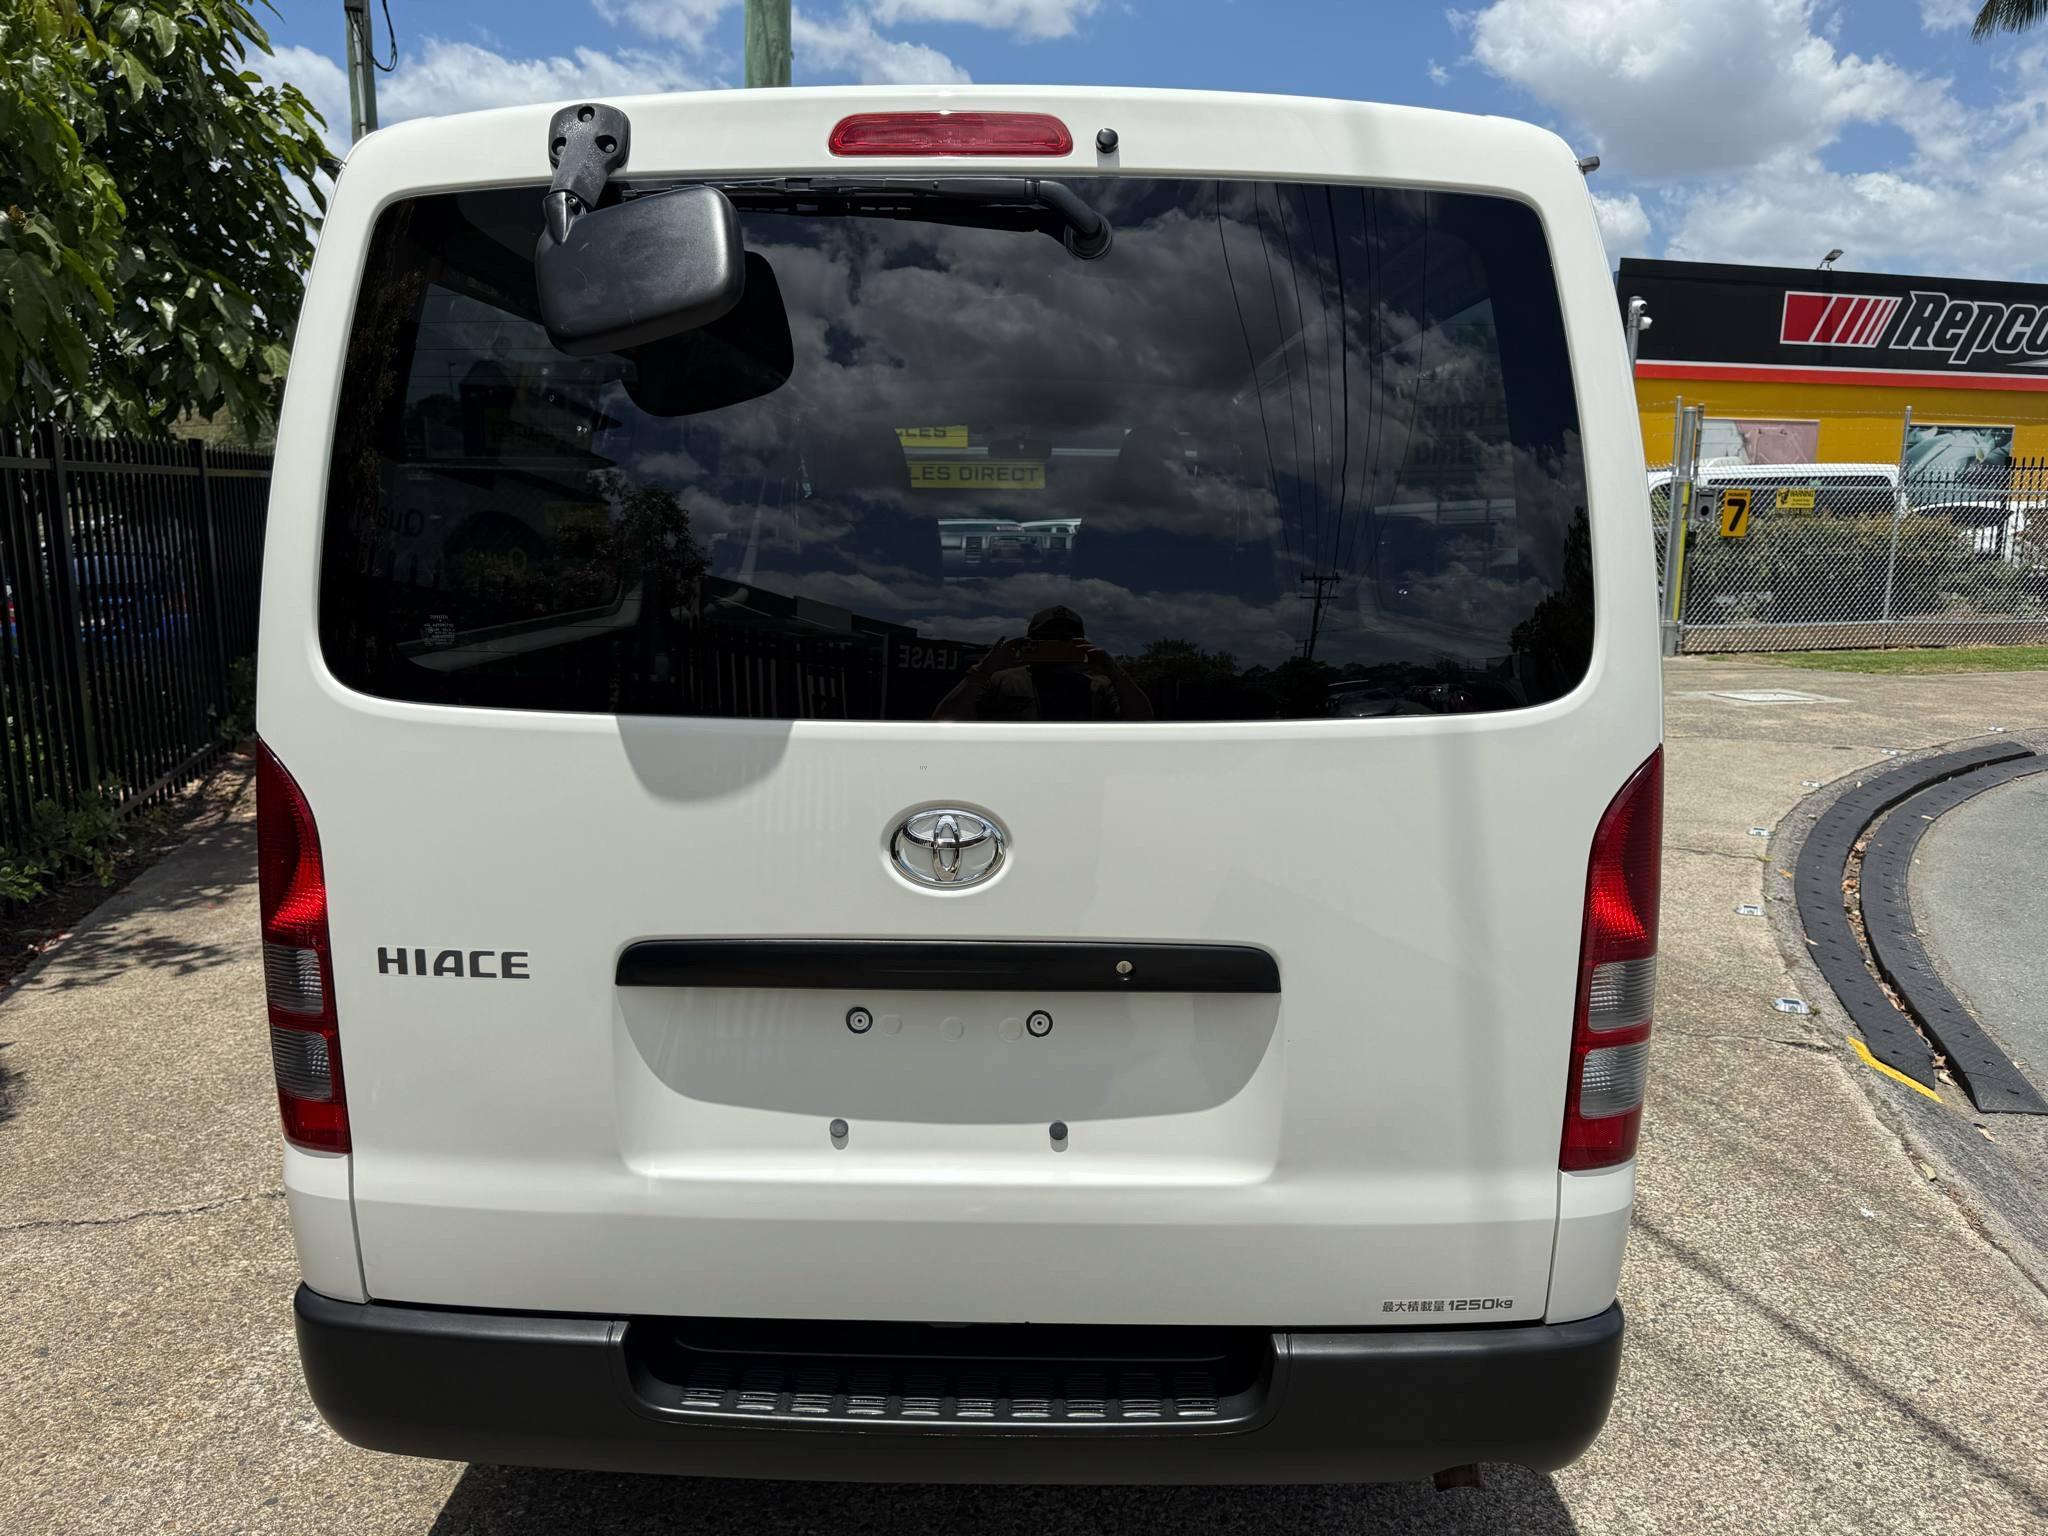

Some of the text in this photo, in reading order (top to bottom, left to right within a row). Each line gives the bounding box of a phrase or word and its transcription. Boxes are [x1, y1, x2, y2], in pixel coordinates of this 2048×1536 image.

[896, 426, 947, 438] LES
[959, 466, 1039, 481] DIRECT
[1727, 498, 1747, 532] 7
[377, 946, 531, 979] HIACE
[1382, 1297, 1514, 1313] 最大積載量 1250kg
